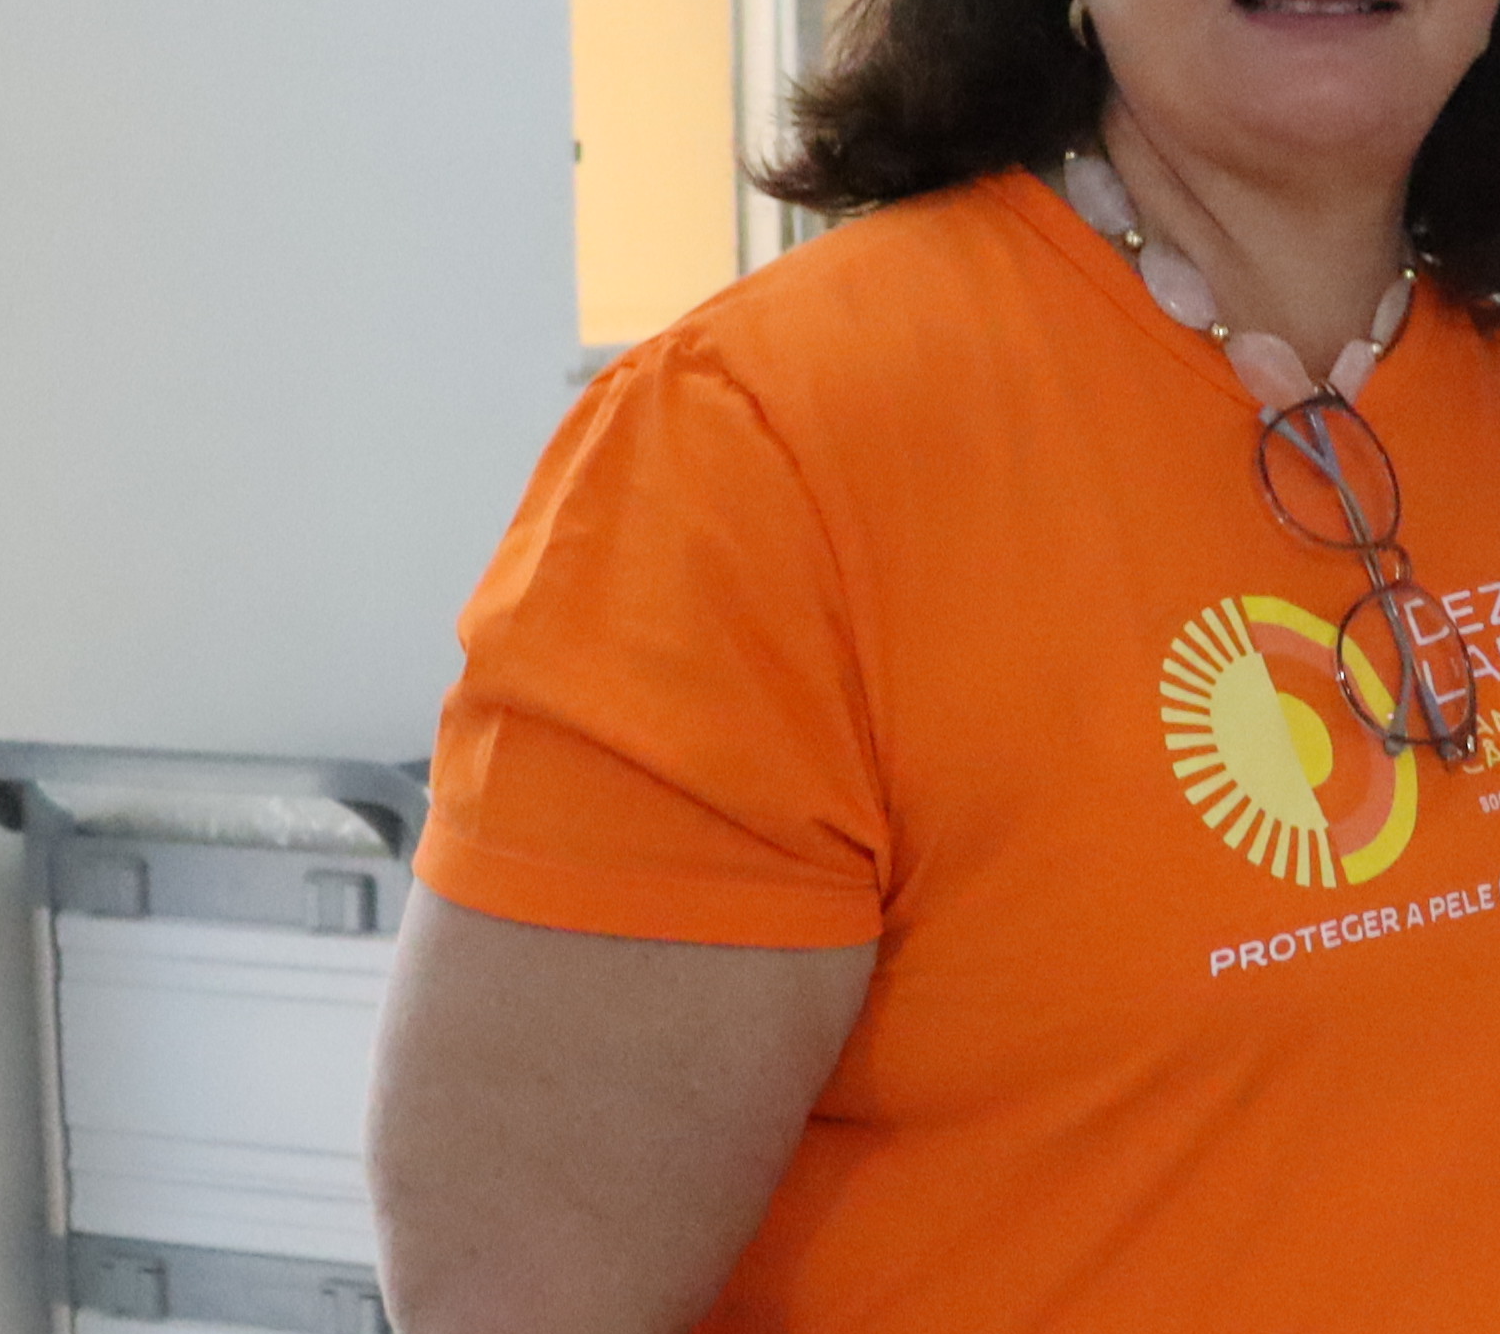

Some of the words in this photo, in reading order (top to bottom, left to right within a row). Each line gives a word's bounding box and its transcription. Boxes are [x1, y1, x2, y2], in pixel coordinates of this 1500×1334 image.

[1209, 906, 1401, 977] PROTEGER
[1406, 902, 1424, 929] A
[1429, 883, 1495, 923] PELE
